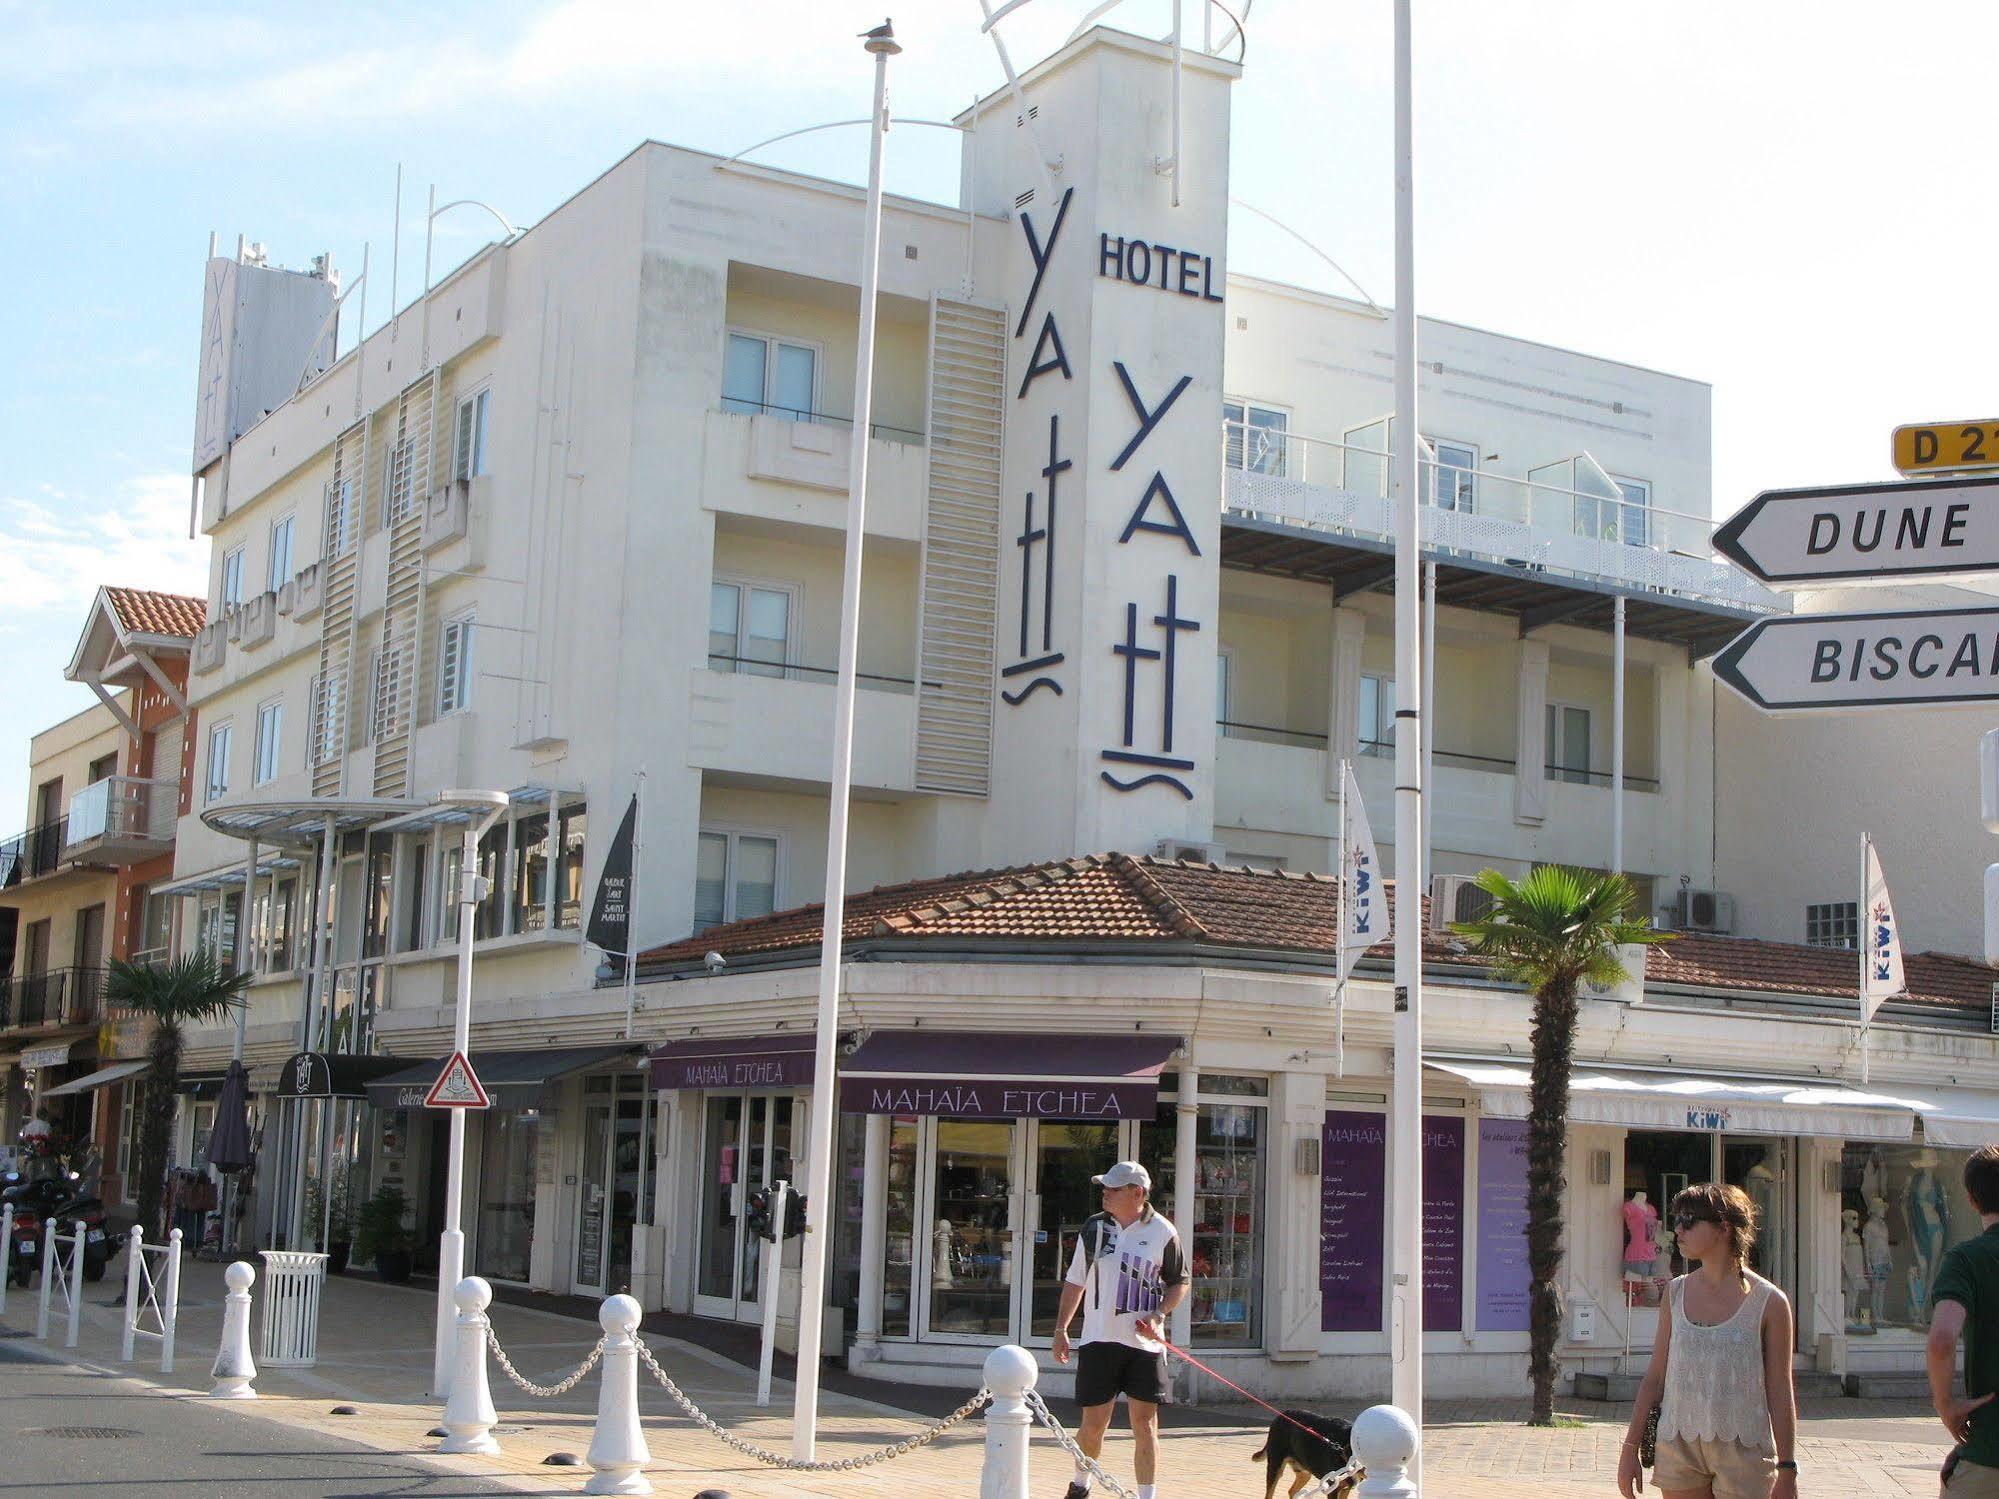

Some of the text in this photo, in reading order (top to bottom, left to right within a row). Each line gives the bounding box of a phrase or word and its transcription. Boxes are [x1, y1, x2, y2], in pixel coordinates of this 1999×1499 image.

[1099, 231, 1225, 304] HOTEL
[1914, 426, 1999, 464] D 2
[1807, 503, 1970, 555] DUNE
[1810, 632, 1999, 685] BISCA
[601, 913, 626, 922] MARTIN
[604, 904, 625, 913] SAINT
[686, 1062, 784, 1084] MAHAÏA ETCHEA
[872, 1086, 1122, 1115] MAHAÏA ETCHEA
[1328, 1127, 1384, 1144] MAHAÏA
